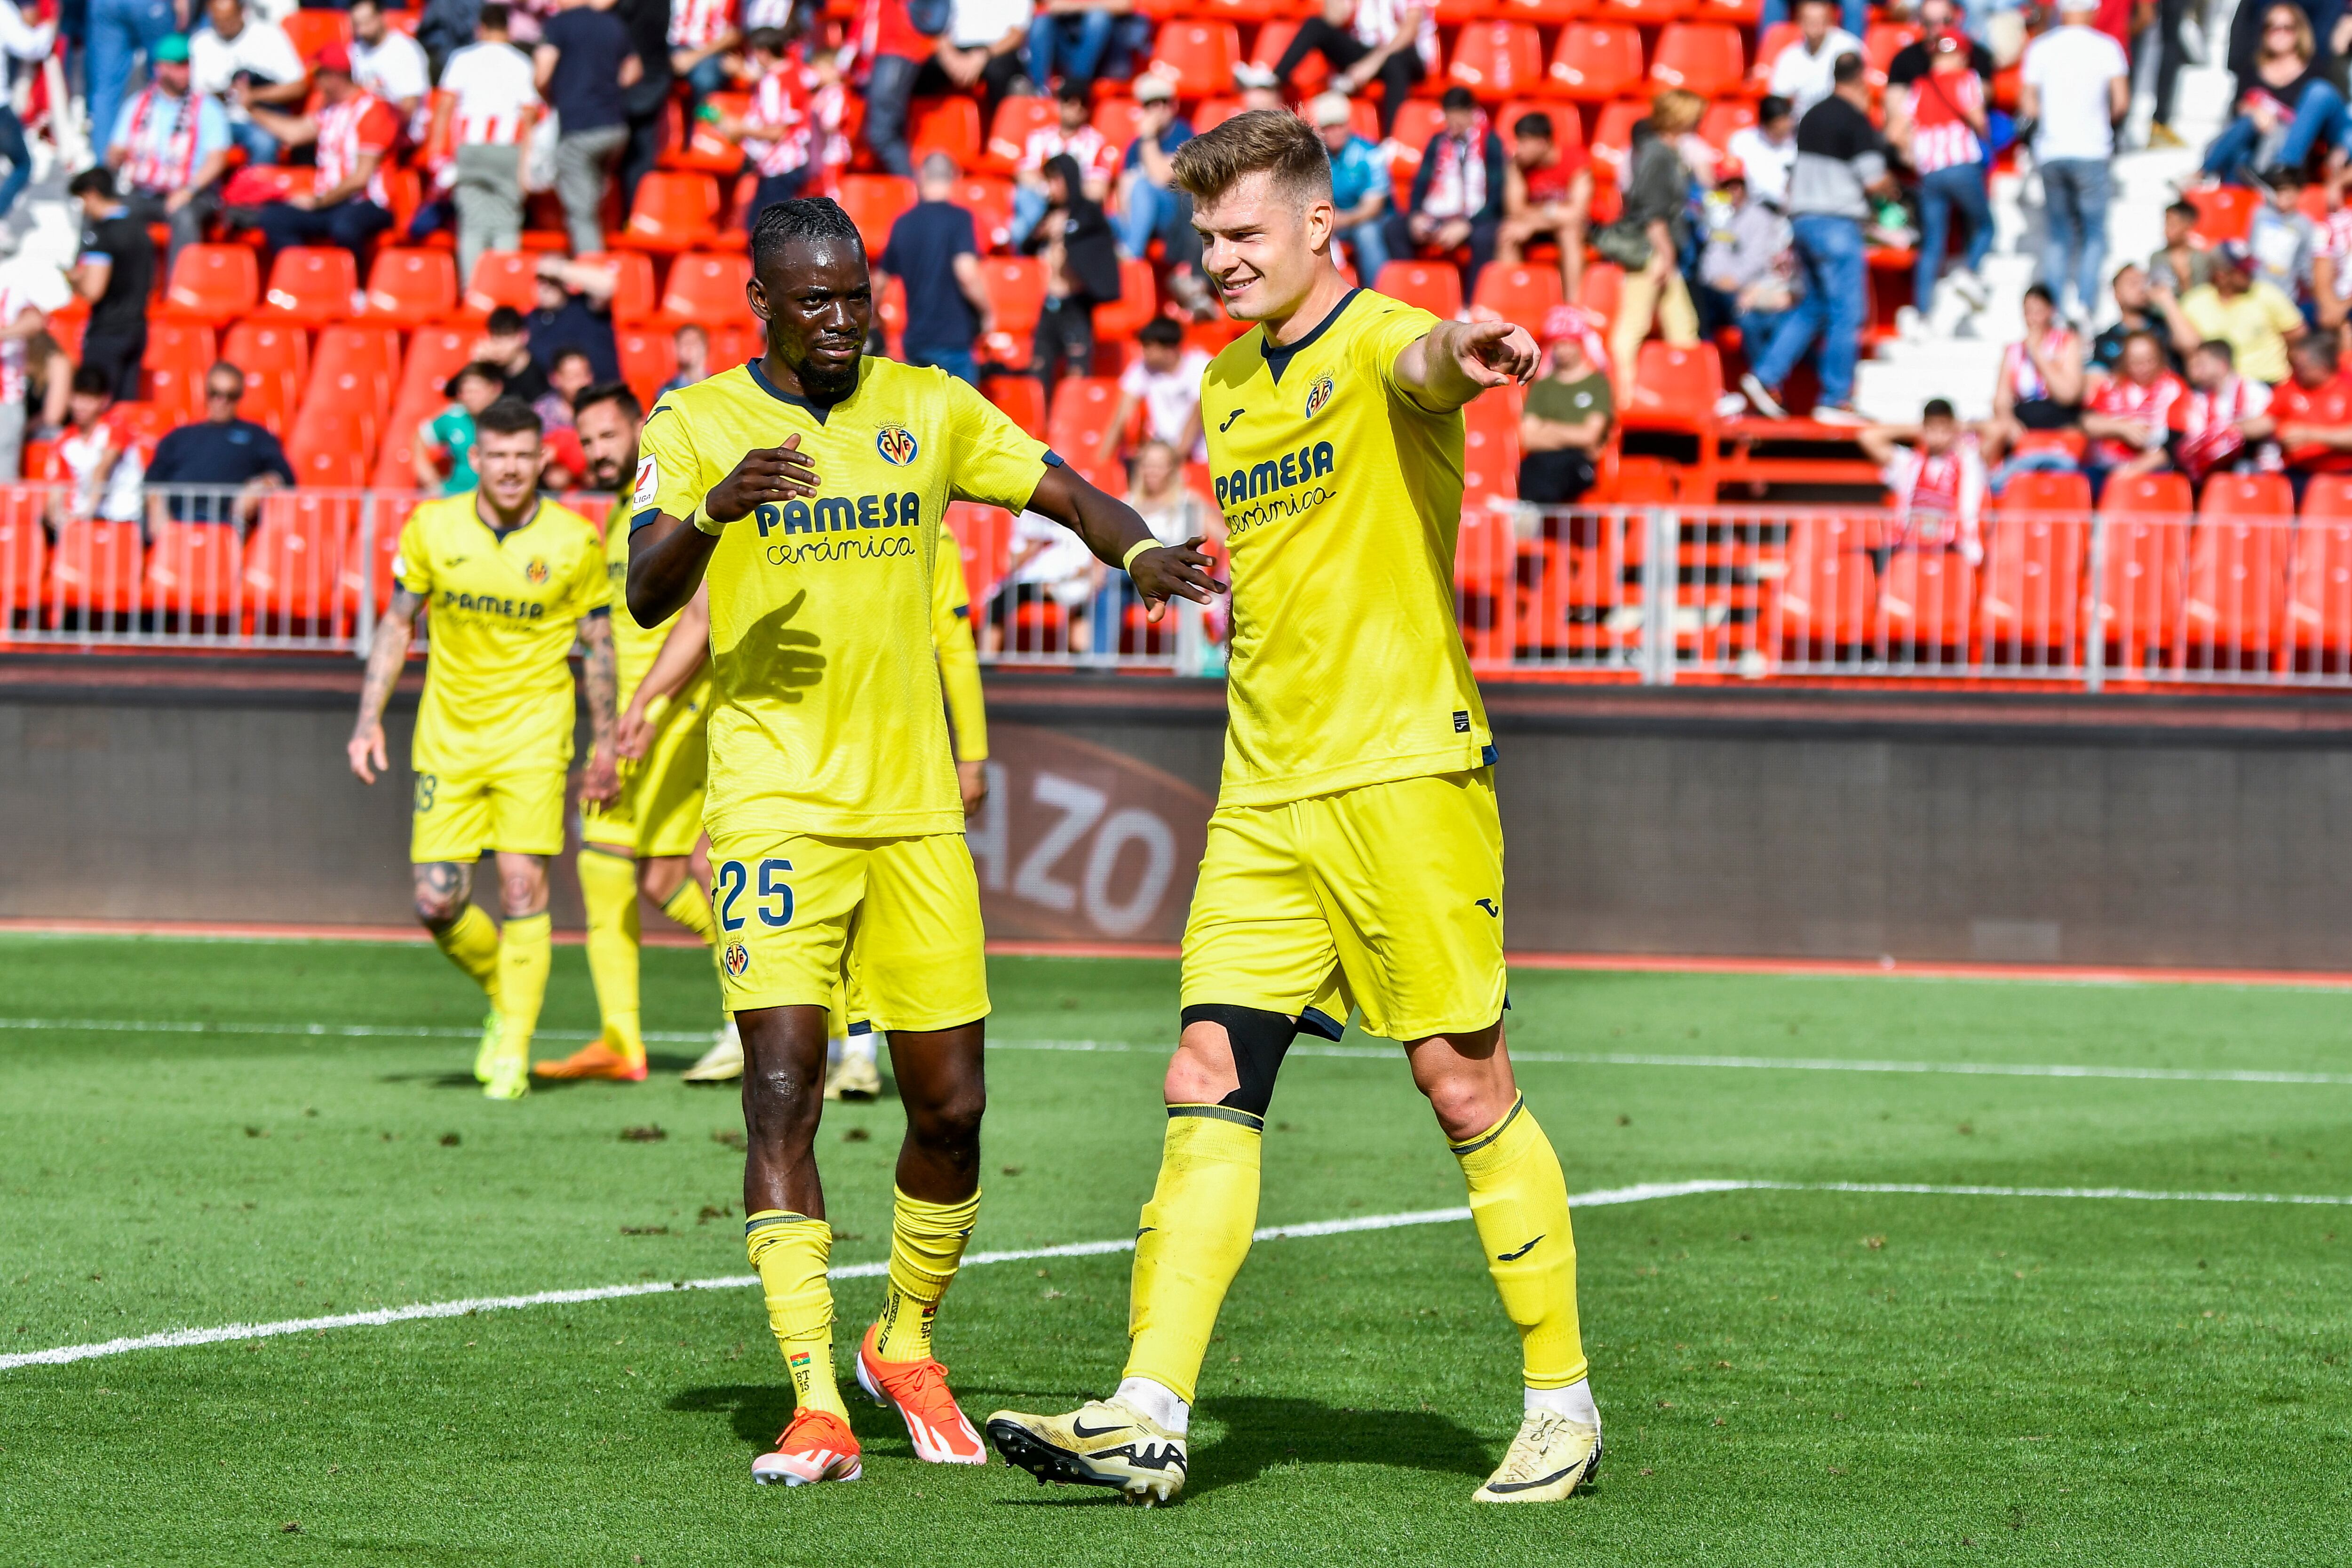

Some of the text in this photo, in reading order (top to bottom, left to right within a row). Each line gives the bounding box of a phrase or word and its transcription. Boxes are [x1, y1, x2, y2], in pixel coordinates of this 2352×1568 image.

[1216, 441, 1334, 511] PAMESA
[755, 492, 920, 537] PAMESA
[767, 535, 915, 565] cerámica
[444, 591, 543, 619] PAMESA
[720, 859, 794, 932] 25
[795, 1369, 810, 1383] BT
